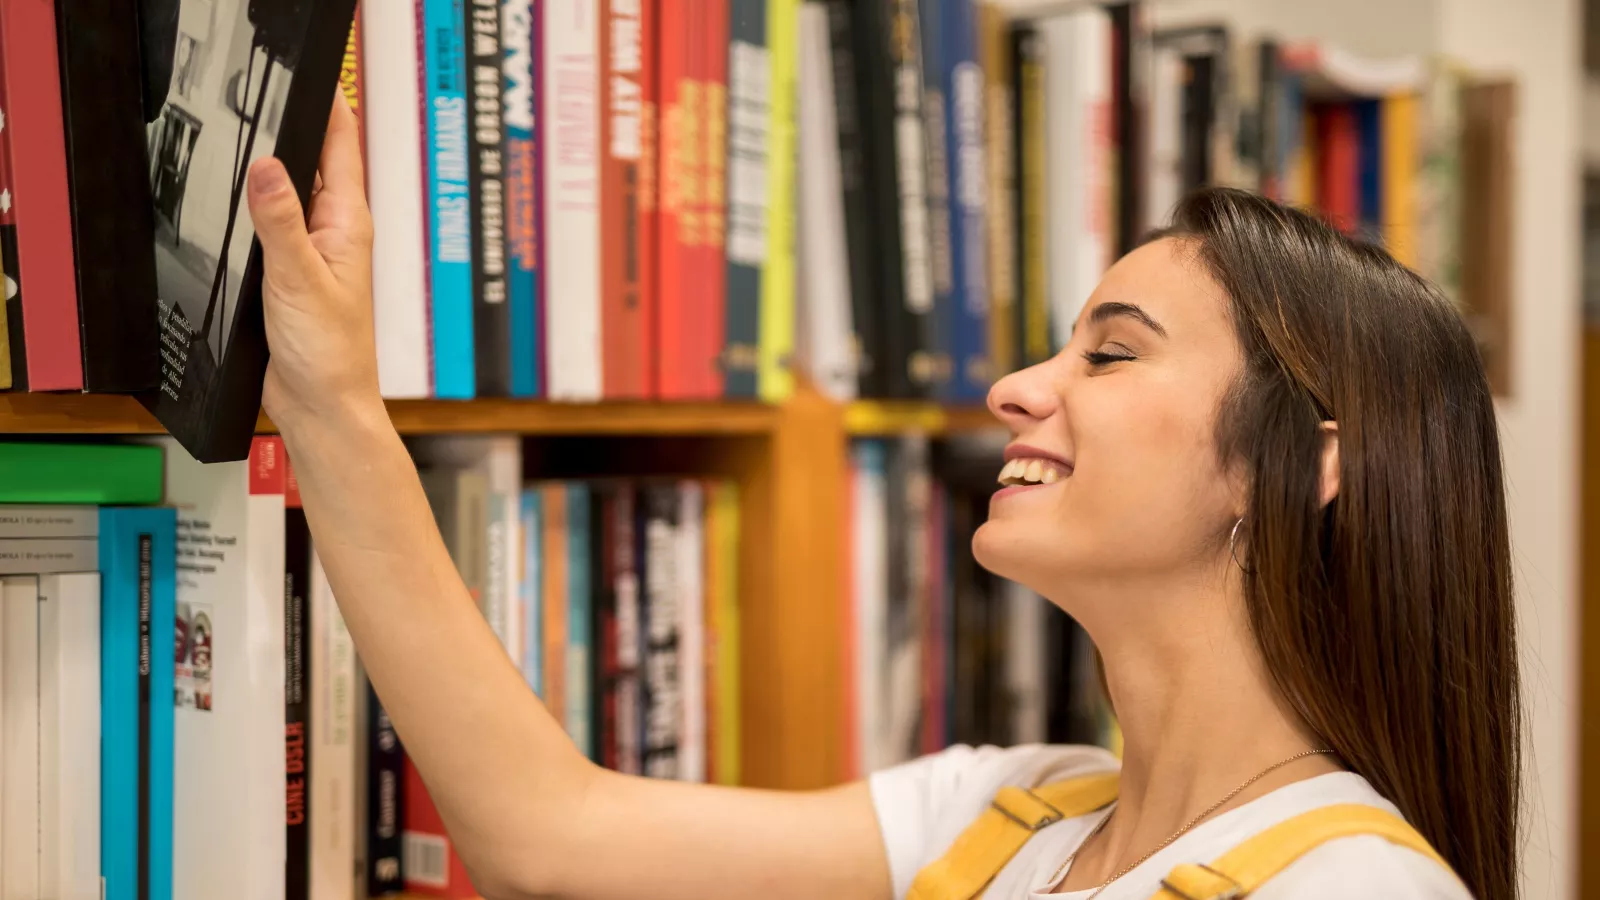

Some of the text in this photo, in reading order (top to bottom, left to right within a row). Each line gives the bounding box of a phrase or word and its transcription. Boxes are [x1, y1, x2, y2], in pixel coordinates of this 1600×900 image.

[474, 65, 501, 145] ORSON
[434, 96, 467, 181] HUMANAS
[480, 149, 502, 175] DE
[480, 180, 504, 275] UNIVERSO
[483, 279, 505, 303] EL
[286, 721, 304, 774] DSLR
[286, 777, 304, 825] CINE
